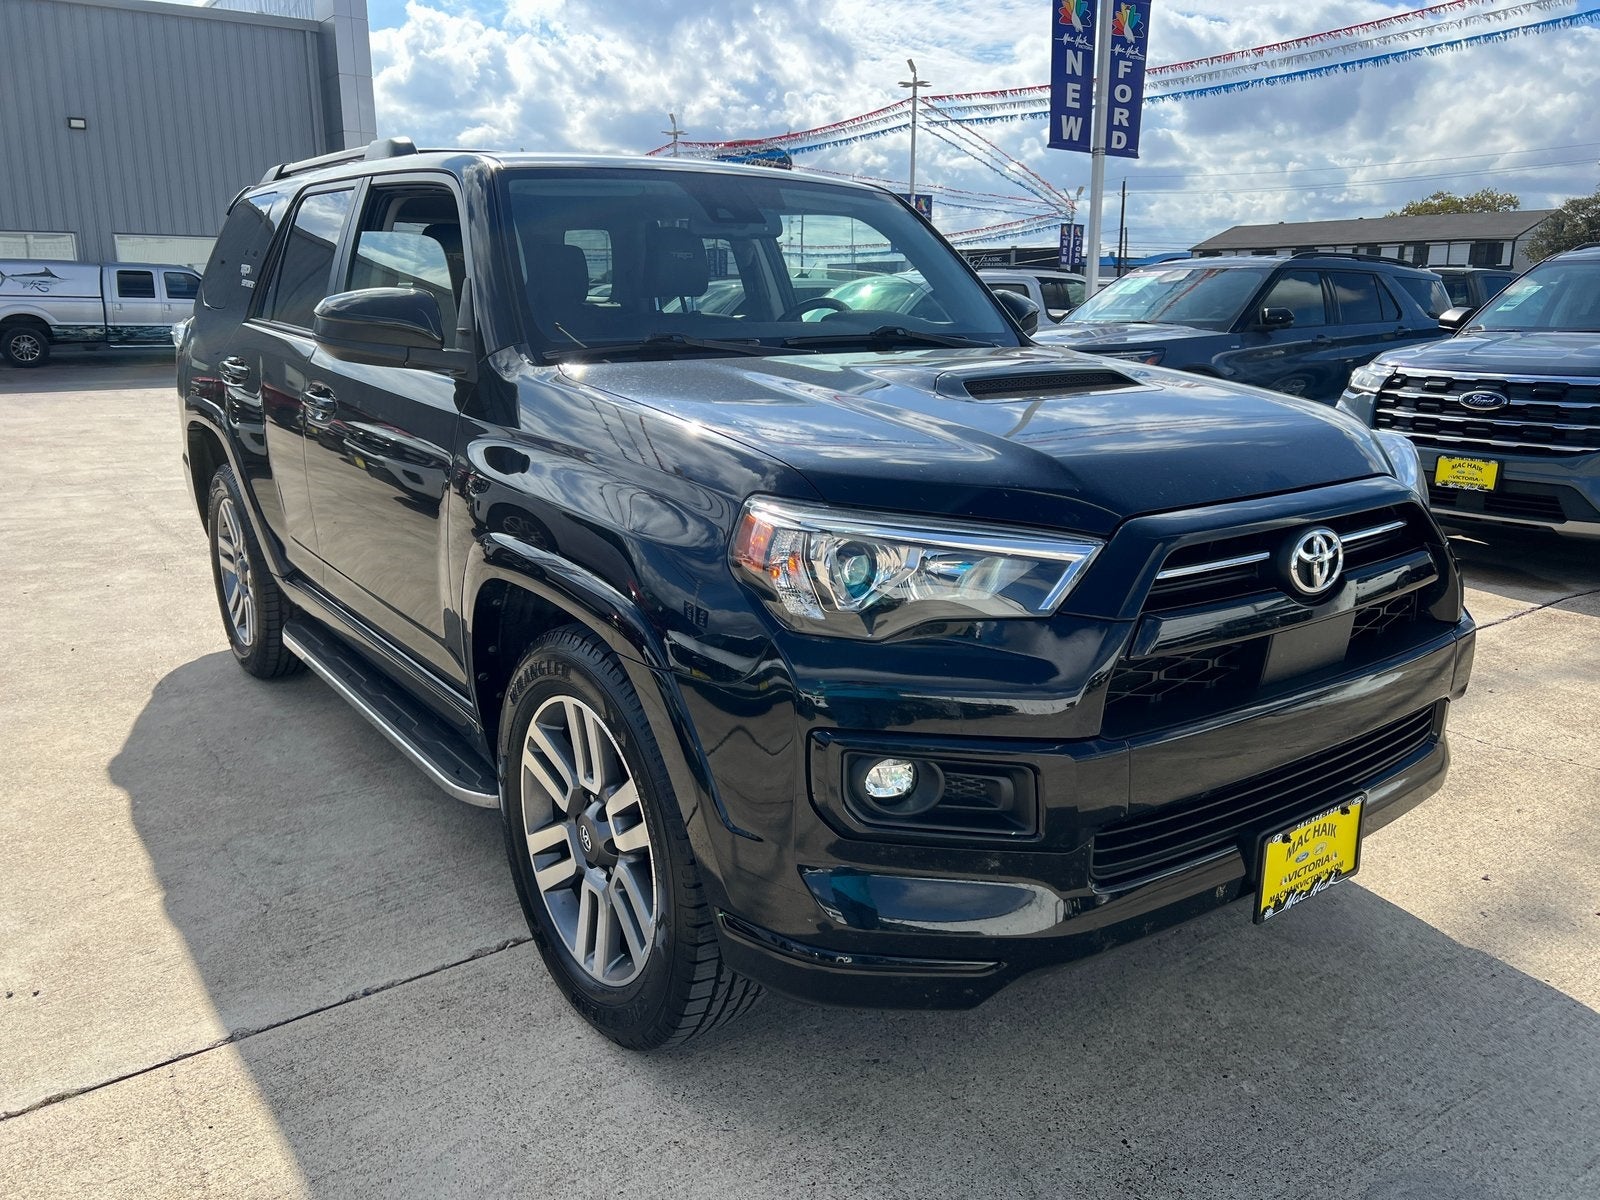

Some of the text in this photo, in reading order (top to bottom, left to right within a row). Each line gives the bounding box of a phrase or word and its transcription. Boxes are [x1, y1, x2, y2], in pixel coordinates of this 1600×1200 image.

[1061, 49, 1083, 142] NEW
[1111, 60, 1133, 150] FORD
[1469, 394, 1496, 406] Ford
[1451, 462, 1467, 470] MAC
[1285, 822, 1338, 862] MAC HAIK
[1287, 854, 1330, 883] VICTORIA
[1284, 891, 1309, 911] Mac
